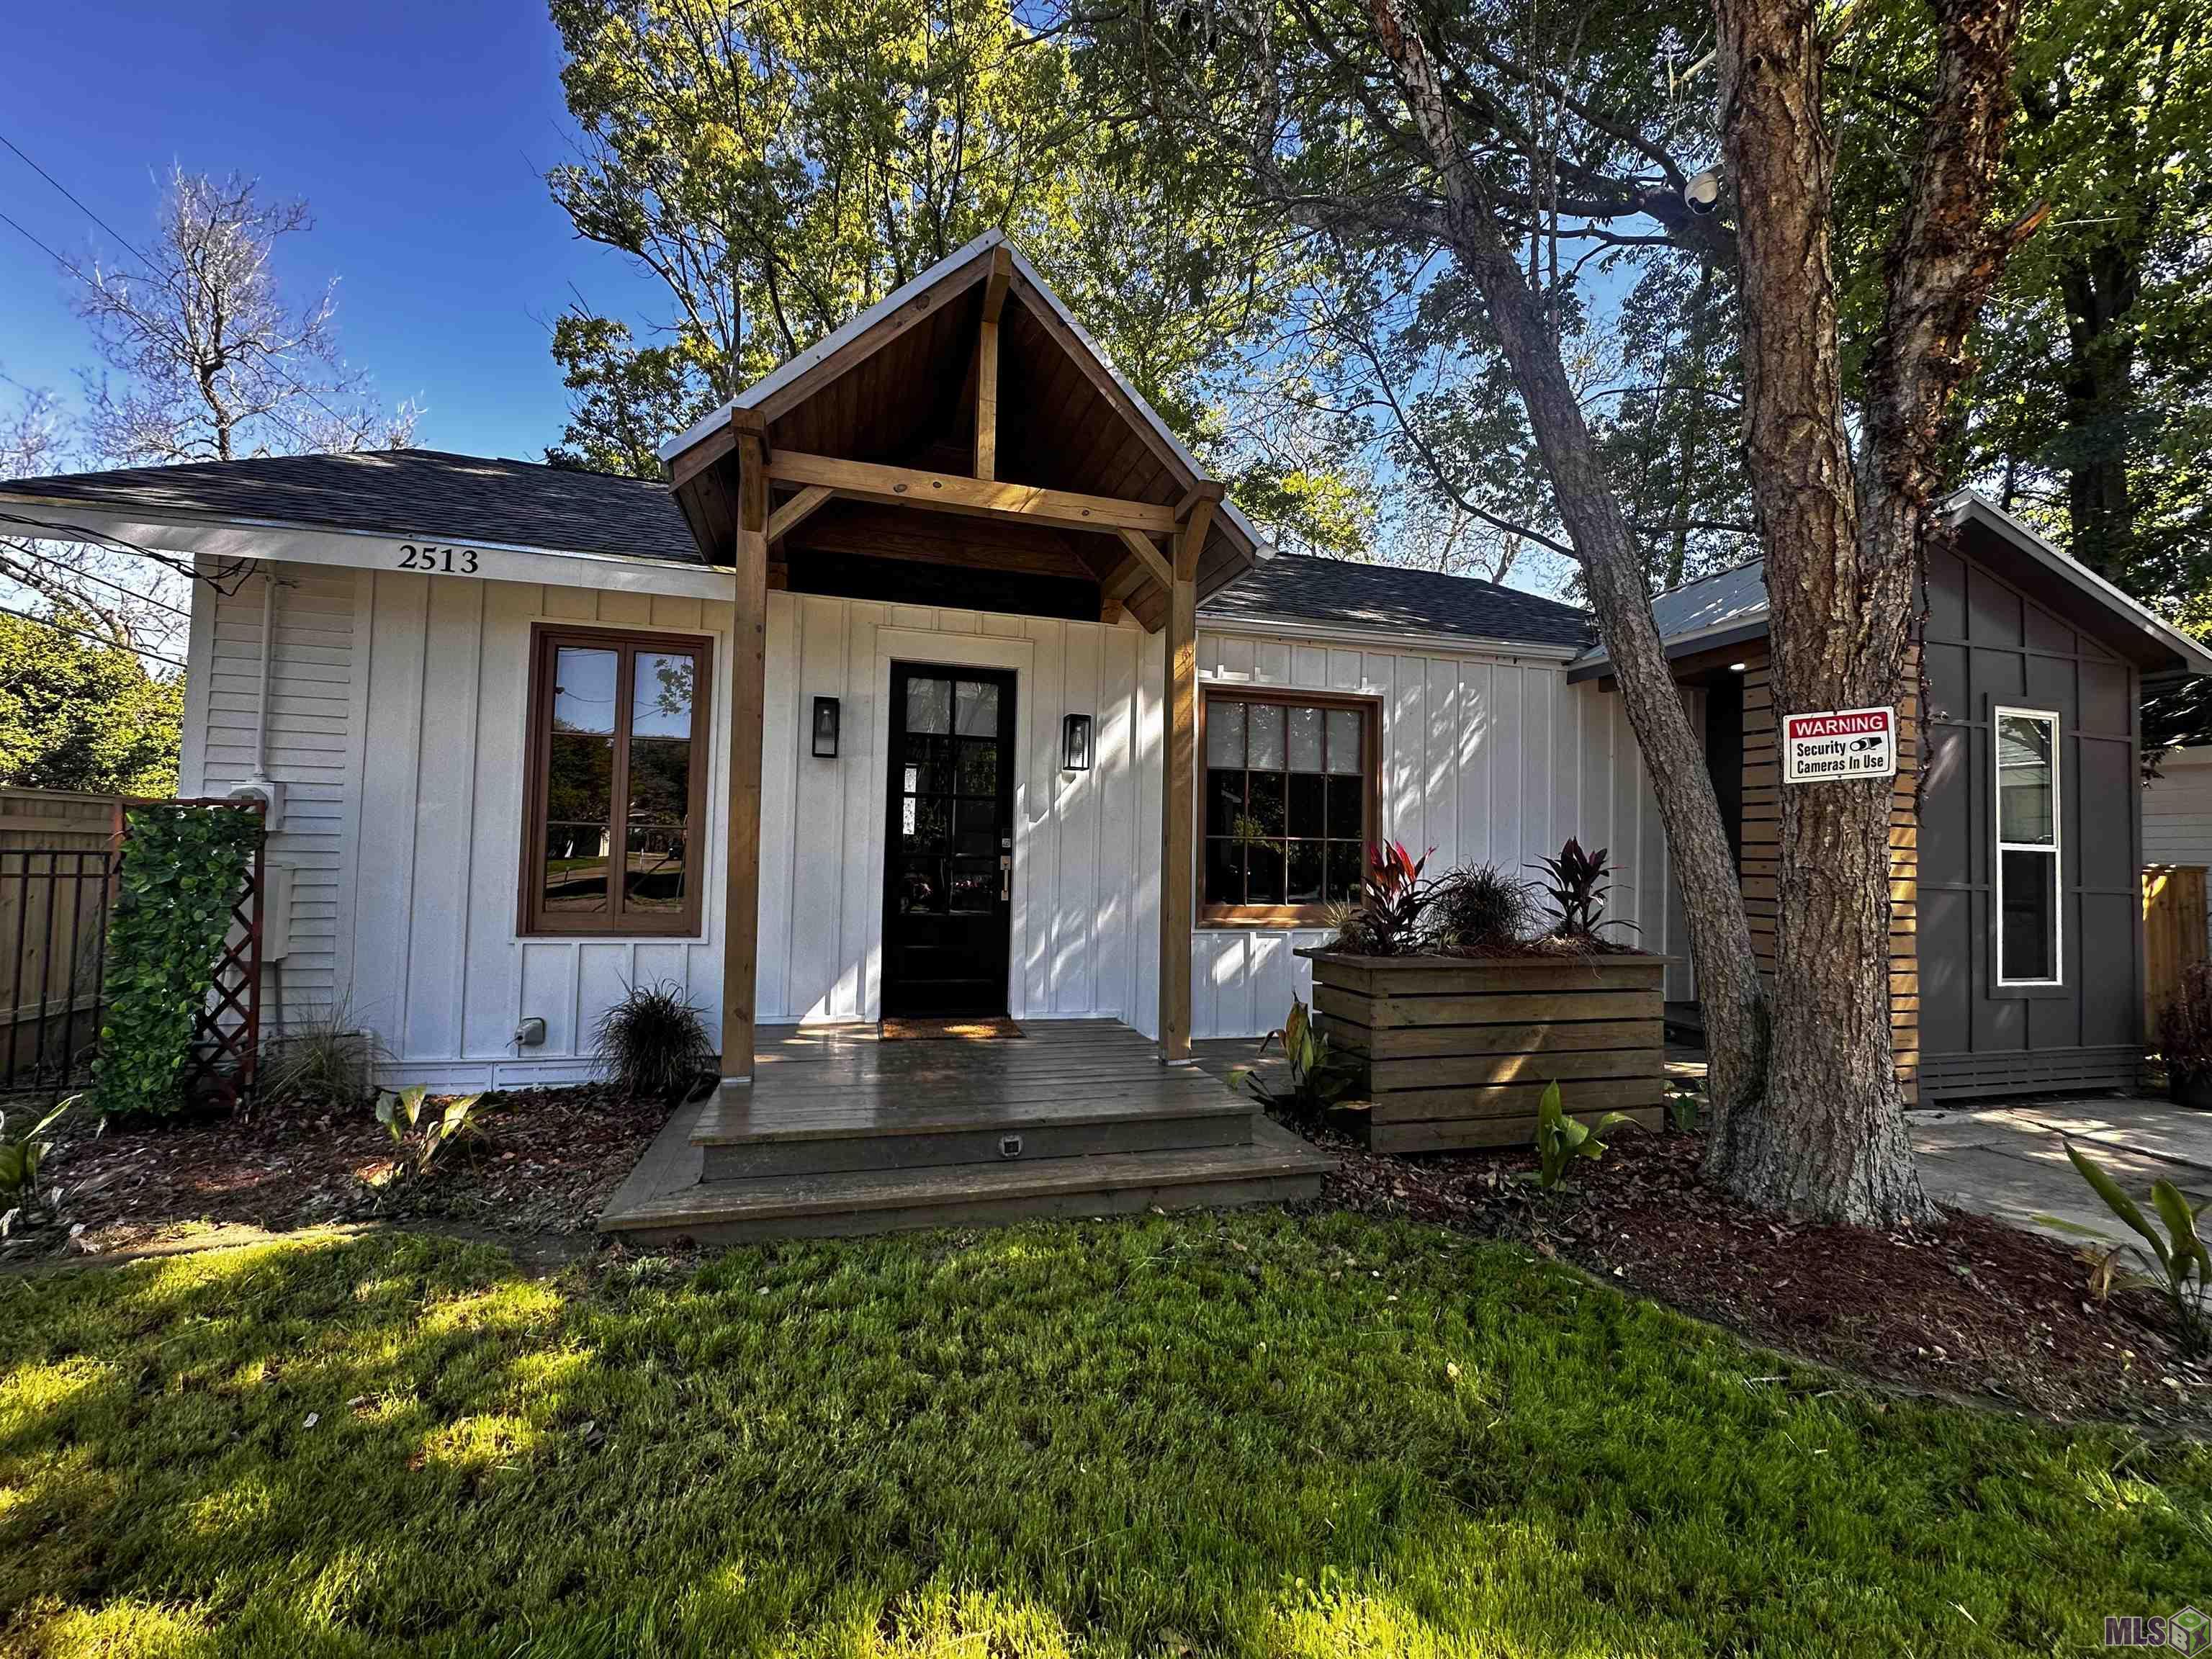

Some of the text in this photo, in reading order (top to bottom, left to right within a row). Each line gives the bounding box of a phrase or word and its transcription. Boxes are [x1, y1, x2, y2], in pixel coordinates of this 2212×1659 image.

[397, 545, 478, 573] 2513
[1796, 716, 1883, 736] WARNING
[1797, 740, 1845, 757] Security
[1797, 755, 1884, 774] Cameras In Use
